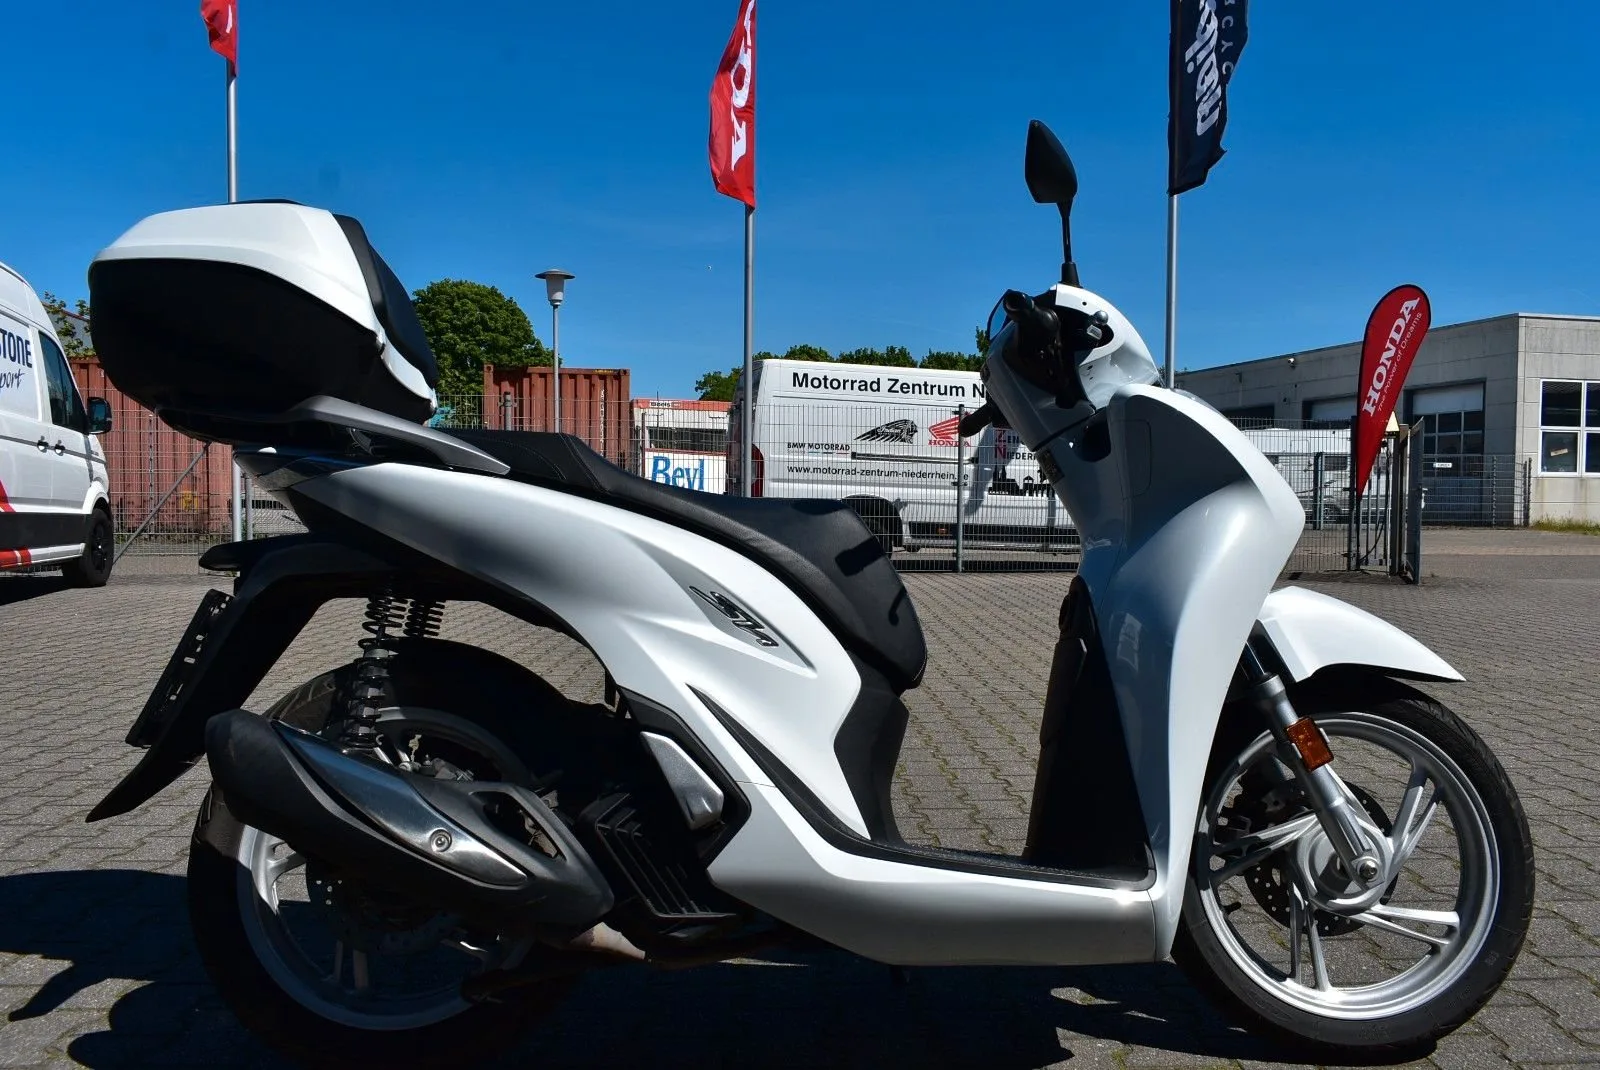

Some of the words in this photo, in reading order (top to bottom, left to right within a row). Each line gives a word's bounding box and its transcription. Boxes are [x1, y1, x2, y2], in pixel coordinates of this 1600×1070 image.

[0, 327, 32, 368] TONE
[1362, 297, 1420, 417] HONDA
[1377, 394, 1386, 412] The
[1383, 363, 1398, 393] Power
[1395, 350, 1403, 362] of
[1400, 312, 1422, 349] Dreams
[792, 372, 881, 393] Motorrad
[887, 378, 965, 397] Zentrum
[972, 383, 985, 398] N
[928, 440, 972, 448] HONA
[995, 429, 1020, 444] ZEN
[808, 443, 850, 451] MOTORRAD
[787, 466, 969, 480] www.motorrad-zentrum-niederrhein.e
